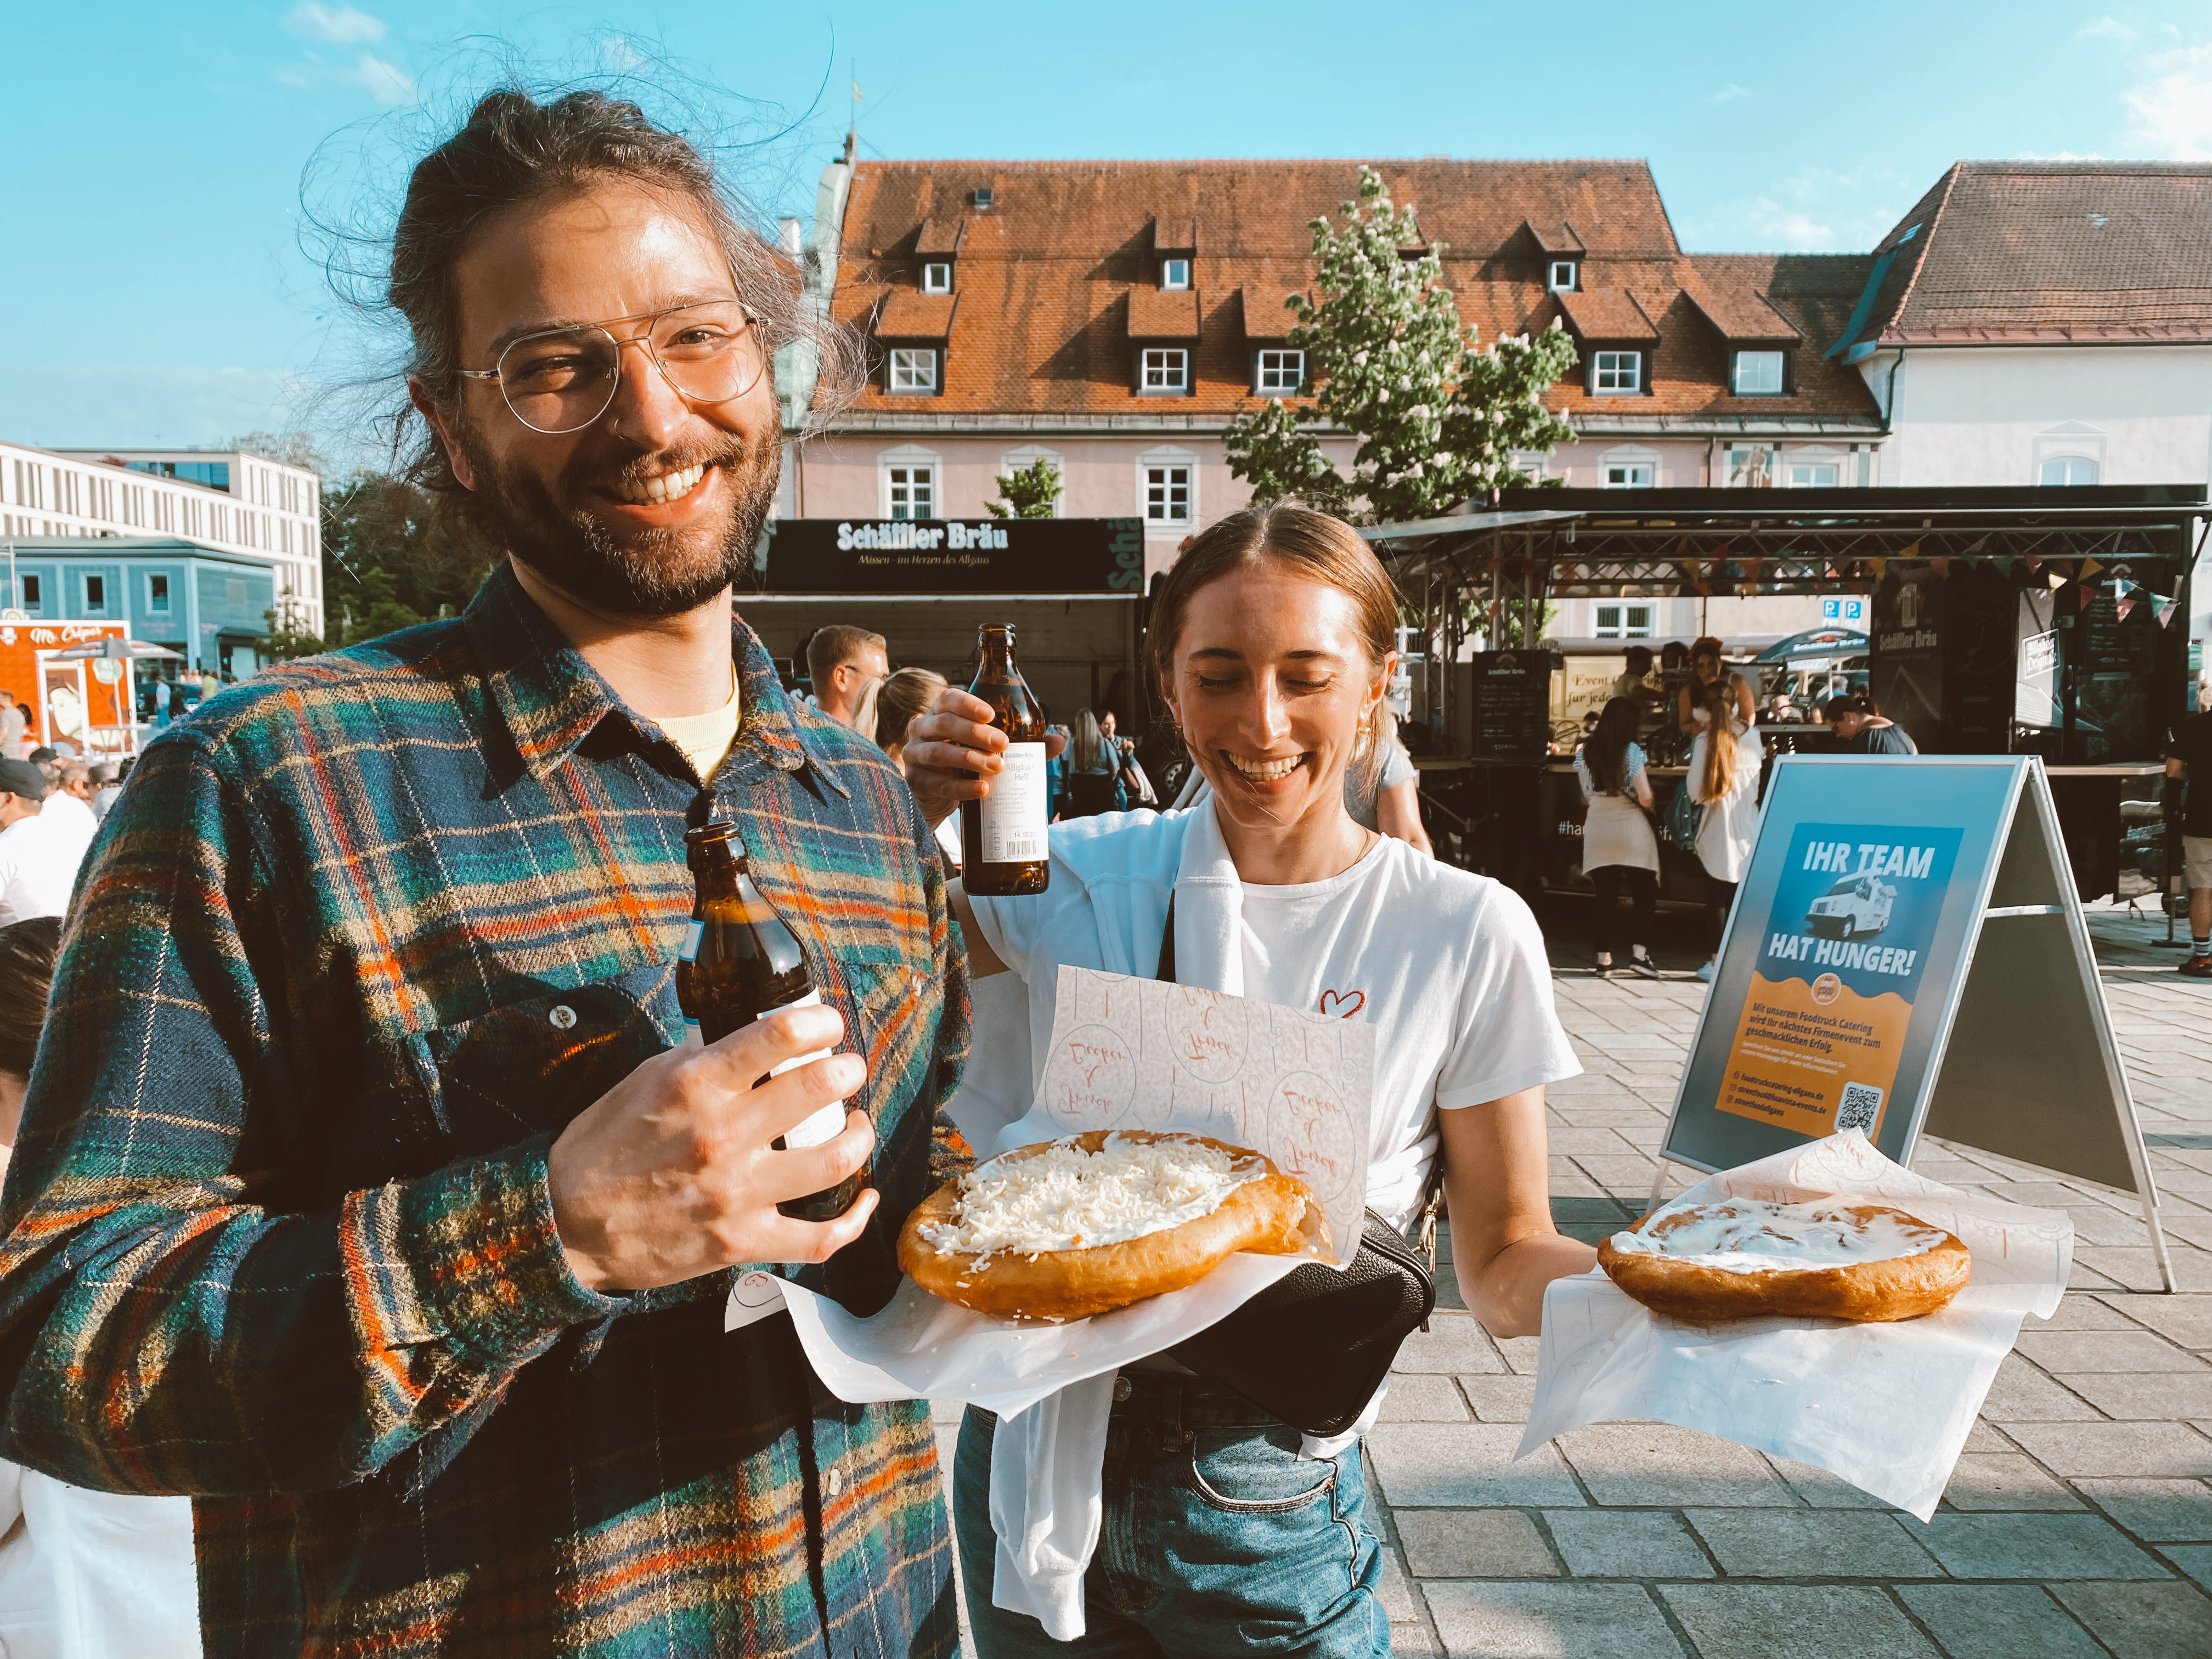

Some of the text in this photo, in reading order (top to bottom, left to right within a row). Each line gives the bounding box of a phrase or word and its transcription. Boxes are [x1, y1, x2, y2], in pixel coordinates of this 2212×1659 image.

[947, 522, 1008, 549] Bräu
[858, 555, 889, 564] Missen
[912, 555, 941, 564] Herzen
[943, 555, 956, 564] des
[958, 554, 990, 567] Allgäus
[1848, 602, 1857, 616] P
[1572, 674, 1608, 686] Event
[1802, 841, 1936, 879] IHR TEAM
[1768, 933, 1917, 977] HAT HUNGER!
[1750, 1014, 1881, 1048] wird Ihr nächstes Firmenevent zum
[1753, 1003, 1874, 1036] Mit unserem Foodtruck Catering
[1745, 1026, 1833, 1054] geschmacklichen Erfolg.
